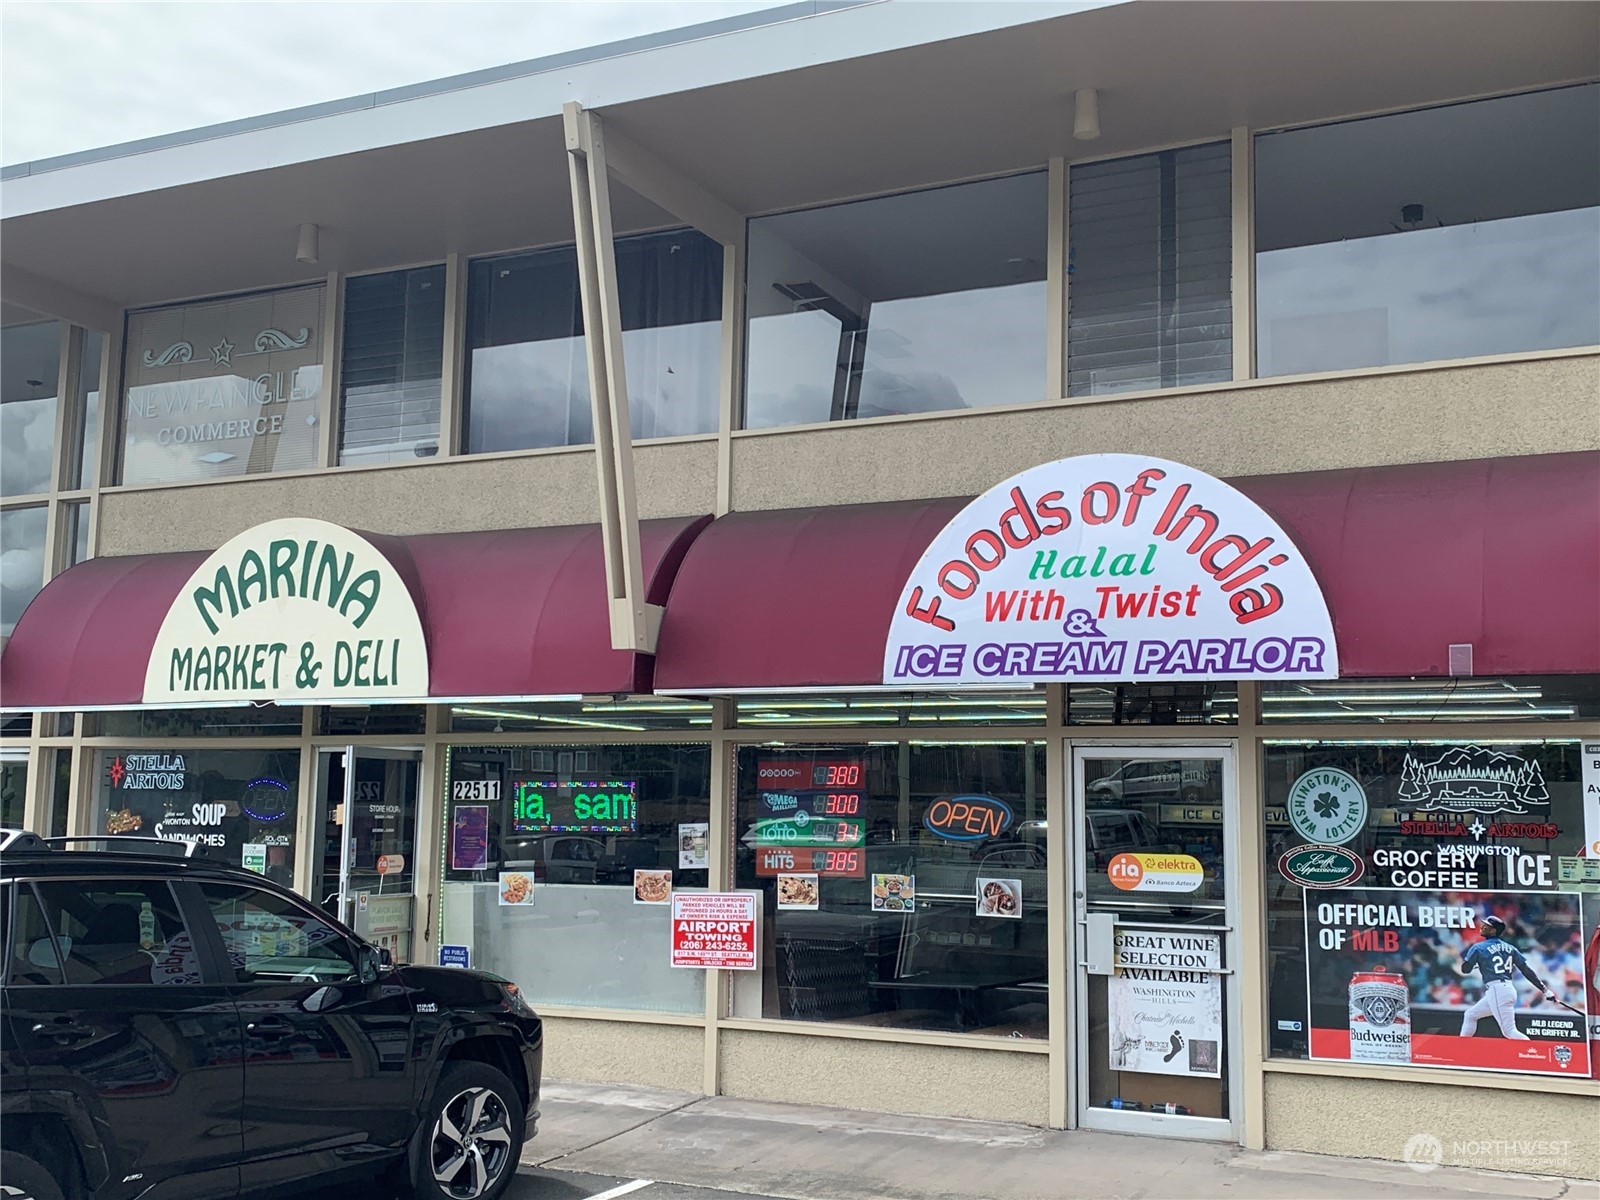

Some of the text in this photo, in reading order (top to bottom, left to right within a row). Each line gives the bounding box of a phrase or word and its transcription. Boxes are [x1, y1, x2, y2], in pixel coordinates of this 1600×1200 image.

[158, 415, 283, 445] COMMERCE
[906, 468, 1288, 633] Foods of India
[1029, 543, 1156, 580] Halal
[193, 539, 380, 635] MARINA
[984, 584, 1201, 623] With Twist
[1064, 608, 1107, 638] &
[169, 638, 400, 691] MARKET & DELI
[894, 637, 1325, 678] ICE CREAM PARLOR
[125, 755, 185, 771] STELLA
[123, 773, 185, 789] ARTOIS
[455, 782, 498, 800] 22511
[775, 795, 798, 805] MEGA
[520, 786, 550, 825] la,
[826, 795, 859, 813] 300
[1295, 774, 1350, 835] WASHINGTON'S
[192, 803, 226, 826] SOUP
[930, 801, 1004, 836] OPEN
[1183, 809, 1203, 819] ICE
[1326, 801, 1359, 838] LOTTERY
[763, 828, 798, 840] LOTTO
[837, 823, 859, 842] 31
[1400, 821, 1558, 839] STELLA ARTOIS
[1437, 844, 1520, 857] WASHINGTON
[764, 855, 794, 869] HIT5
[826, 852, 857, 871] 385
[1112, 858, 1139, 877] ria
[1157, 859, 1196, 870] elektra
[1507, 854, 1552, 886] ICE
[1391, 871, 1478, 888] COFFEE
[1318, 903, 1475, 929] OFFICIAL BEER
[678, 921, 751, 933] AIRPORT
[680, 941, 748, 951] (206) 243-6252
[685, 933, 743, 941] TOWING
[1113, 935, 1214, 951] GREAT WINE
[1319, 929, 1399, 952] OF MLB
[1120, 952, 1207, 967] SELECTION
[1492, 956, 1513, 974] 24
[1119, 969, 1209, 984] AVAILABLE
[1133, 987, 1196, 998] WASHINGTON
[1351, 1028, 1410, 1044] Budweiser
[1541, 1029, 1569, 1037] GRIFFEY
[1570, 1030, 1580, 1038] JR.
